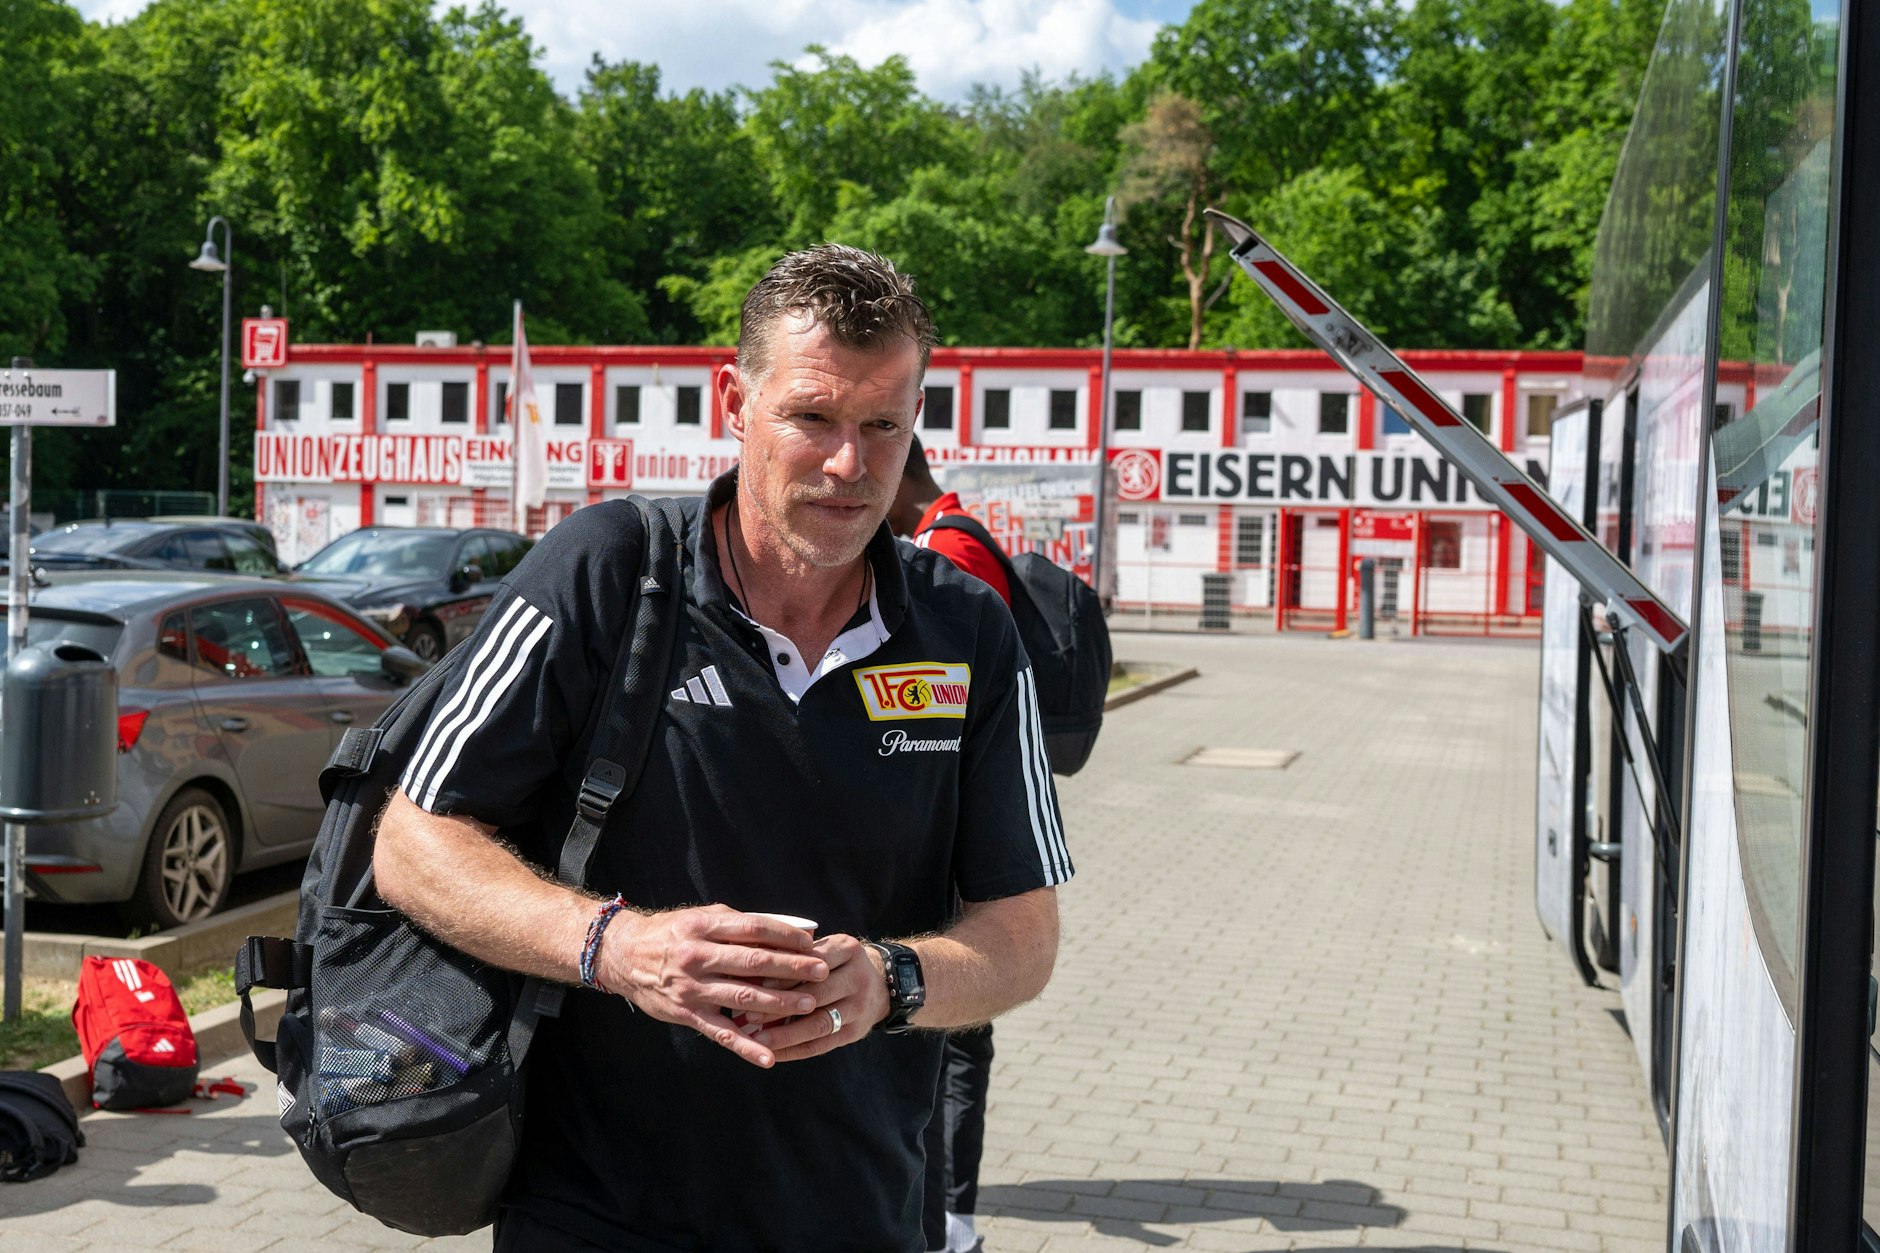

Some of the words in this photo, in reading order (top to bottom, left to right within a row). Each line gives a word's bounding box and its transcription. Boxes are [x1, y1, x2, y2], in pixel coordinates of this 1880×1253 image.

[466, 440, 583, 463] EINNG
[1167, 453, 1352, 501] EISERN
[931, 684, 968, 705] UNION
[878, 730, 962, 757] Paramount
